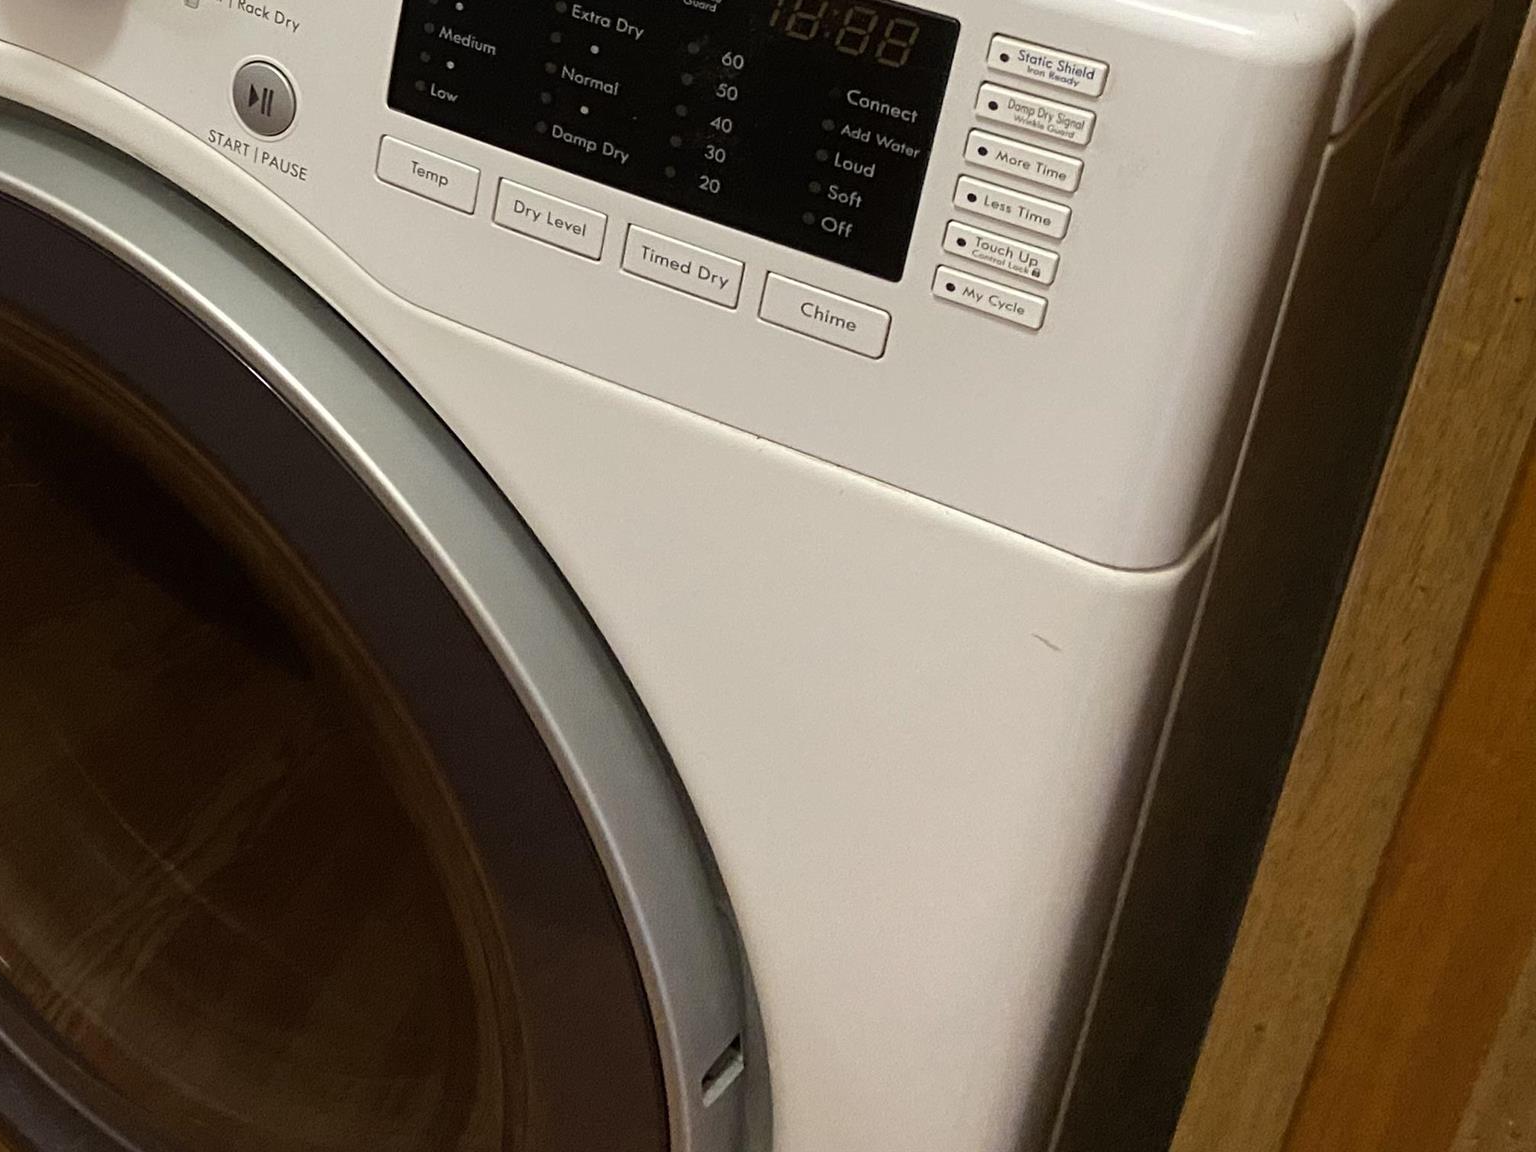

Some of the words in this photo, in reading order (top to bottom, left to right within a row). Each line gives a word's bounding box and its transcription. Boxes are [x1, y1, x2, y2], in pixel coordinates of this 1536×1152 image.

[274, 11, 301, 33] Dry
[571, 4, 611, 29] Extra
[615, 17, 645, 40] Dry
[438, 26, 497, 56] Medium
[721, 51, 744, 70] 60
[1017, 49, 1053, 69] Static
[1056, 60, 1096, 80] Shield
[561, 65, 620, 96] Normal
[1027, 66, 1046, 77] Iron
[1049, 72, 1080, 87] Ready
[430, 83, 458, 102] Low
[716, 84, 738, 101] 50
[846, 89, 918, 123] Connect
[710, 116, 733, 134] 40
[1007, 98, 1035, 116] Damp
[1037, 107, 1054, 123] Dry
[1057, 113, 1085, 130] Signal
[208, 129, 251, 158] START
[261, 151, 308, 182] PAUSE
[552, 124, 597, 152] Damp
[602, 142, 630, 165] Dry
[704, 145, 726, 163] 30
[840, 124, 871, 143] Add
[876, 133, 920, 158] Water
[411, 160, 449, 188] Temp
[834, 152, 876, 178] Loud
[995, 151, 1031, 170] More
[1036, 162, 1067, 181] Time
[699, 175, 721, 194] 20
[827, 185, 863, 208] Soft
[514, 199, 541, 222] Dry
[546, 211, 587, 237] Level
[984, 194, 1011, 214] Less
[1017, 205, 1052, 226] Time
[821, 216, 853, 238] Off
[971, 249, 1005, 266] Control
[1008, 262, 1029, 275] Lock
[975, 236, 1014, 259] Touch
[1018, 251, 1039, 268] Up
[642, 245, 692, 275] Timed
[697, 266, 729, 290] Dry
[962, 286, 984, 303] My
[988, 294, 1025, 315] Cycle
[800, 302, 857, 332] Chime
